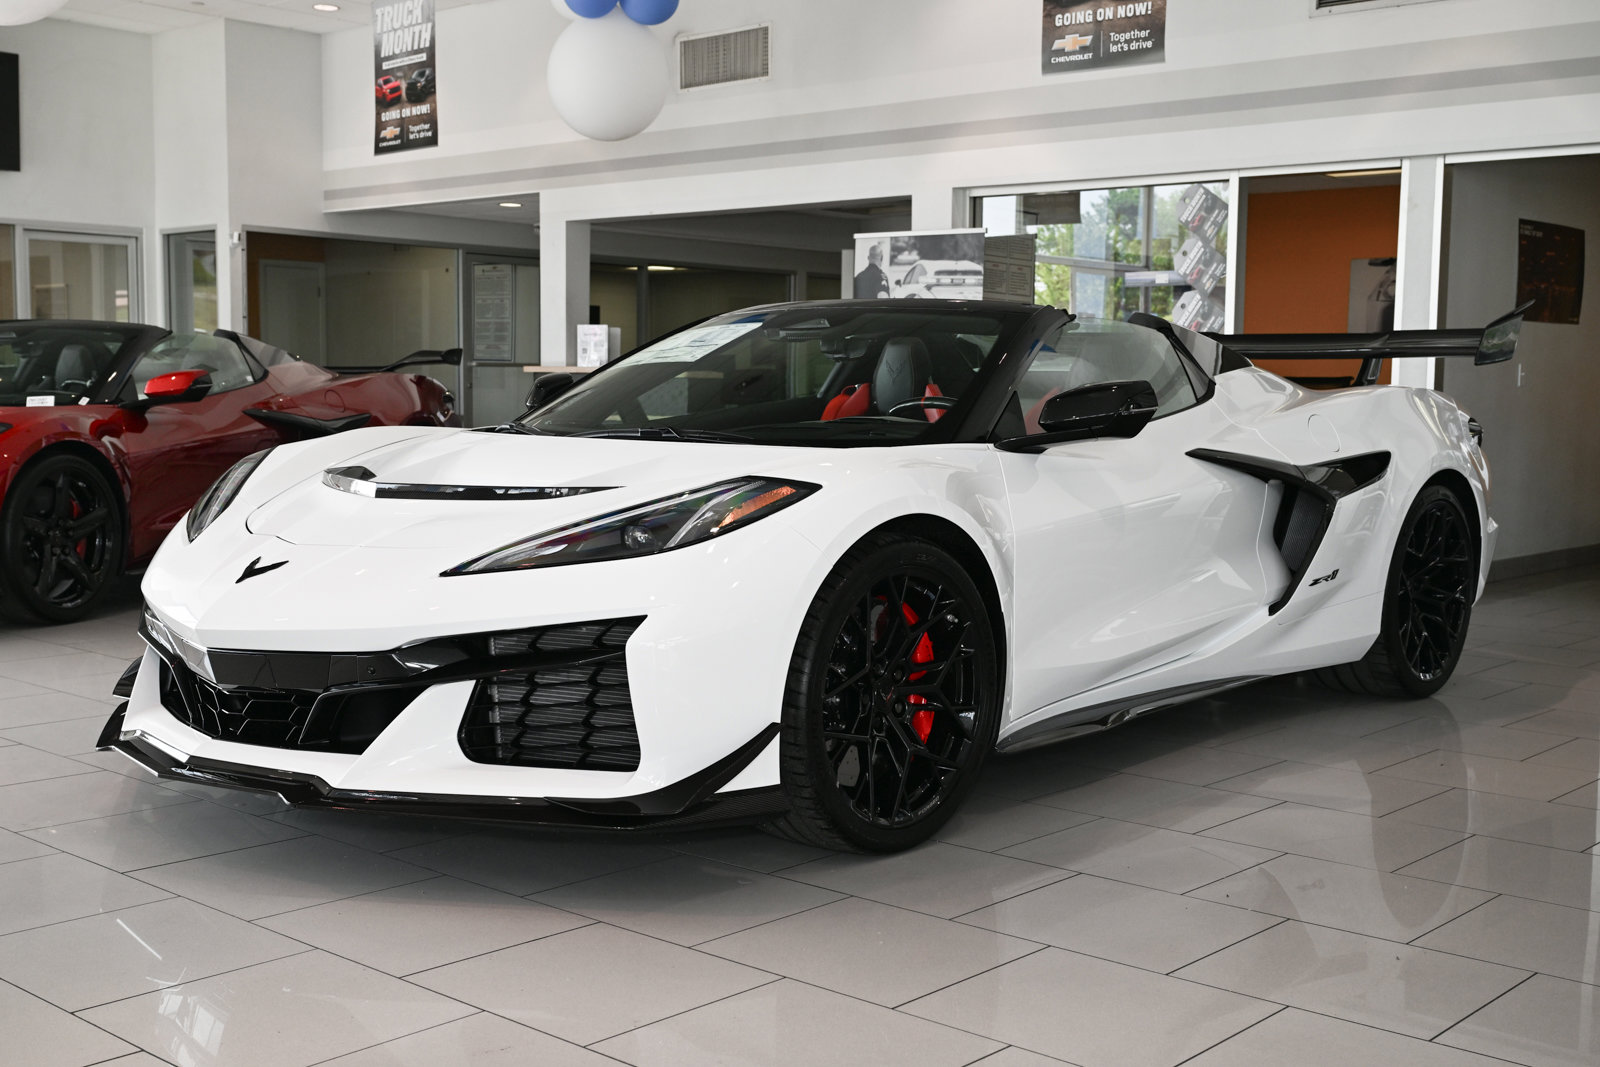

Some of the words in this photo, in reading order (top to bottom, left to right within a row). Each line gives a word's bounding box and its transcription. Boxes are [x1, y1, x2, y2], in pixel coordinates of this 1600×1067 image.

[375, 0, 423, 34] TRUCK
[1055, 9, 1093, 27] GOING
[1096, 6, 1114, 21] ON
[1117, 1, 1152, 19] NOW!
[381, 22, 432, 58] MONTH
[1109, 29, 1150, 42] Together
[1109, 40, 1128, 53] let's
[1130, 39, 1153, 51] drive
[1051, 52, 1093, 64] CHEVROLET
[381, 109, 400, 122] GOING
[401, 108, 411, 118] ON
[411, 103, 430, 116] NOW!
[408, 123, 430, 132] Together
